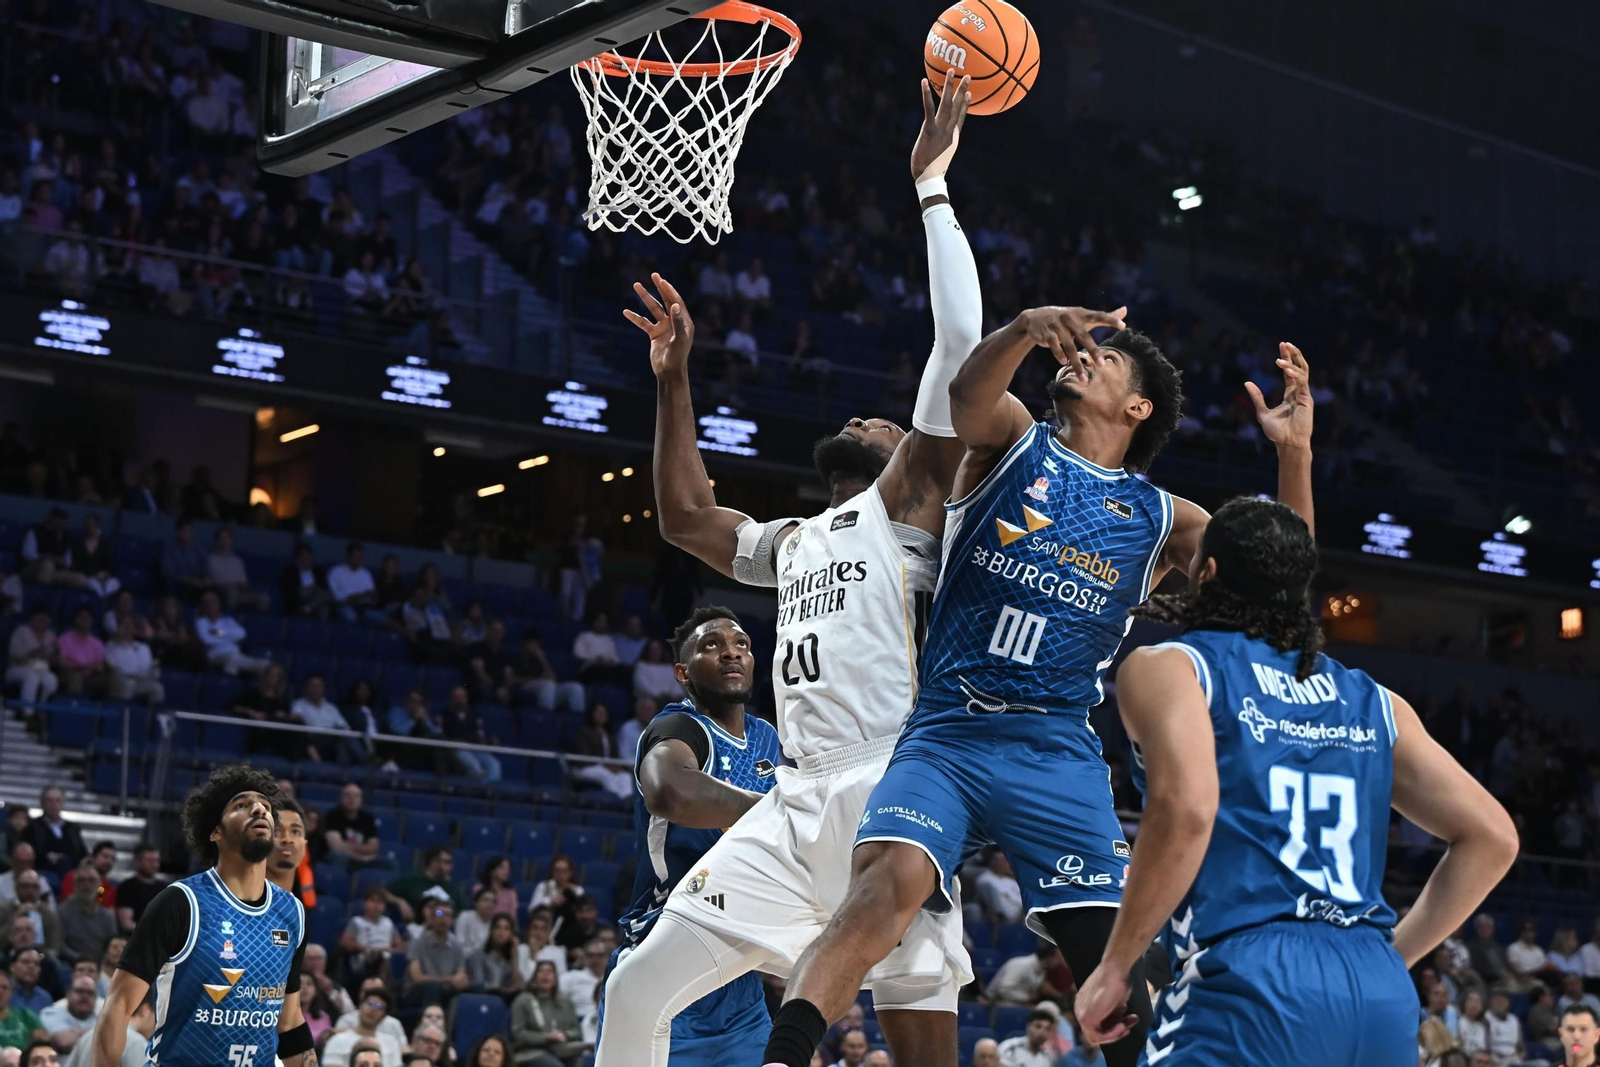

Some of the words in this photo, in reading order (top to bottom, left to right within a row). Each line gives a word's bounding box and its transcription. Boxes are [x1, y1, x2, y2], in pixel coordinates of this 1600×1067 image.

[987, 551, 1093, 609] BURGOS
[799, 587, 846, 623] BETTER
[988, 604, 1048, 666] 00
[780, 632, 821, 687] 20
[1279, 718, 1348, 740] recoletas
[877, 806, 917, 817] CASTILLA
[920, 813, 926, 821] Y
[1268, 764, 1364, 902] 23
[1038, 873, 1112, 889] LEXUS
[210, 1008, 280, 1029] BURGOS
